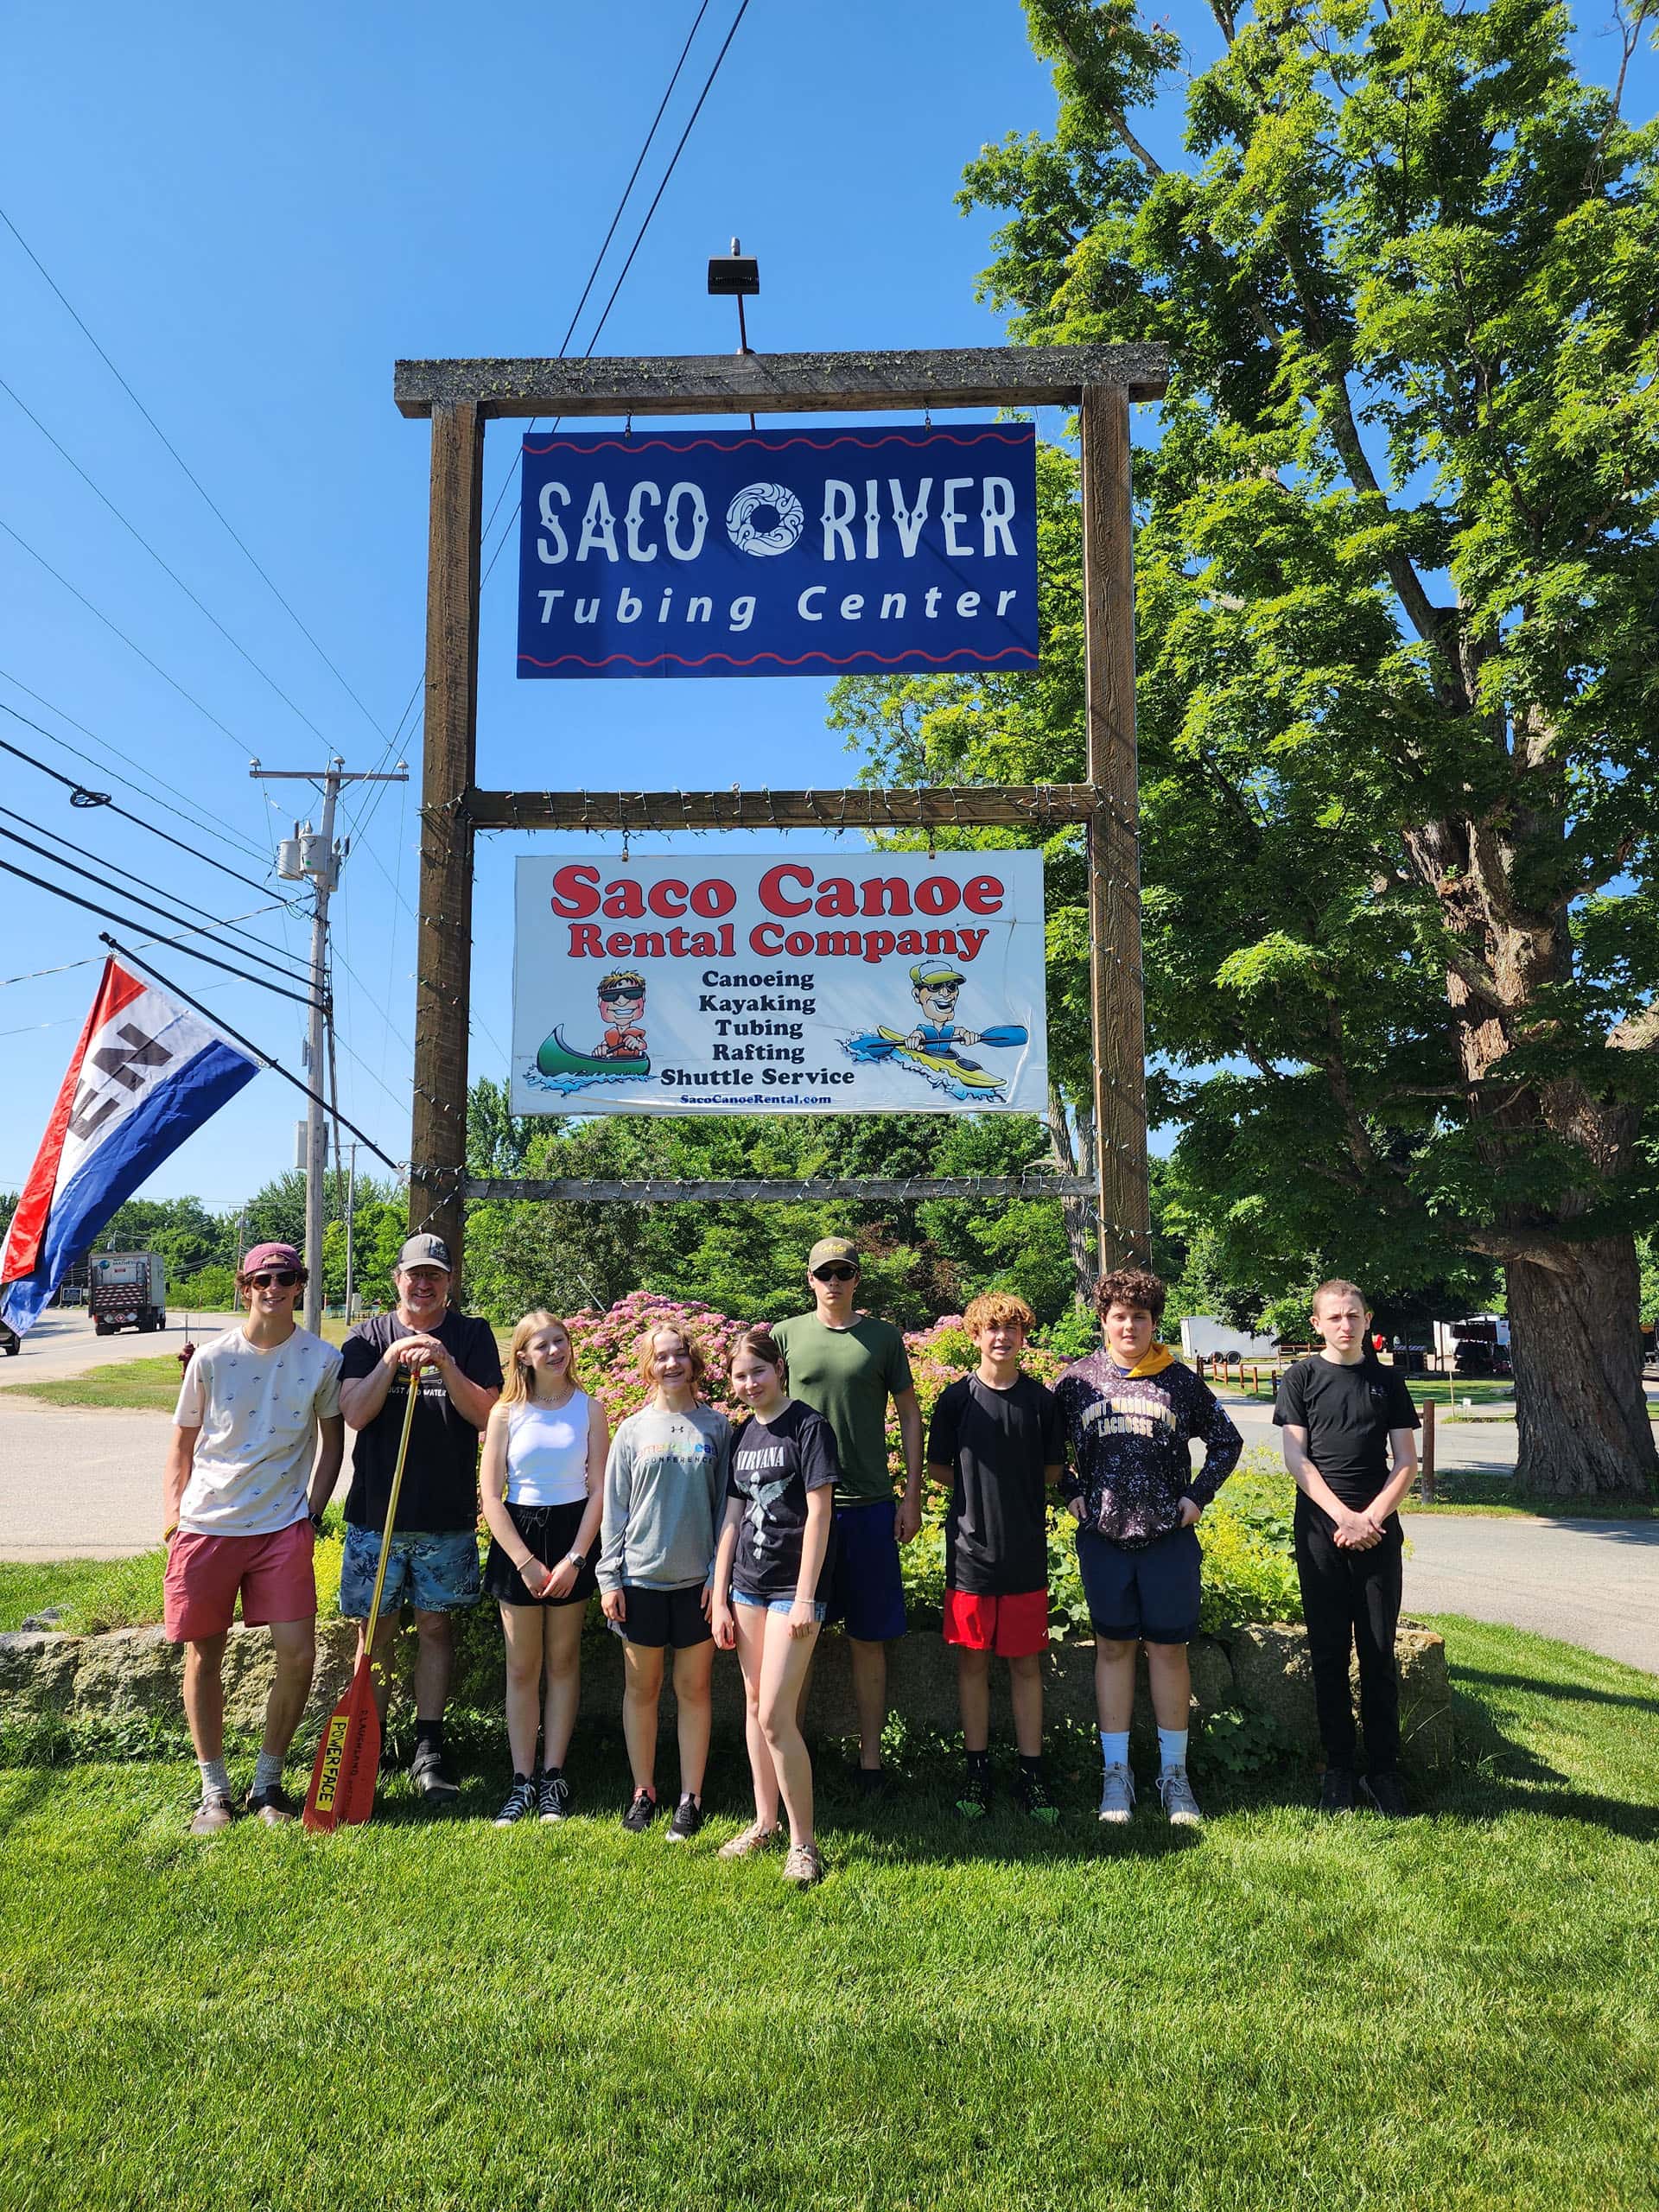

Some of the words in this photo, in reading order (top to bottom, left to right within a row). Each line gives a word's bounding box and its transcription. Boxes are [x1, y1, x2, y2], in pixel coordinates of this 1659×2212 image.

[537, 481, 709, 564] SACO
[819, 477, 1019, 561] RIVER
[537, 588, 756, 632] Tubing
[798, 586, 1017, 621] Center
[551, 864, 737, 919] Saco
[758, 863, 1005, 918] Canoe
[567, 923, 737, 958] Rental
[748, 922, 990, 963] Company
[702, 970, 815, 991] Canoeing
[698, 995, 817, 1015] Kayaking
[715, 1019, 804, 1040] Tubing
[712, 1043, 805, 1065] Rafting
[660, 1068, 754, 1086] Shuttle
[761, 1067, 855, 1086] Service
[680, 1094, 832, 1105] SacoCanoeRental.com
[1097, 1416, 1154, 1439] LACROSSE
[645, 1455, 713, 1465] CONFERENCE
[736, 1446, 785, 1471] NIRVANA
